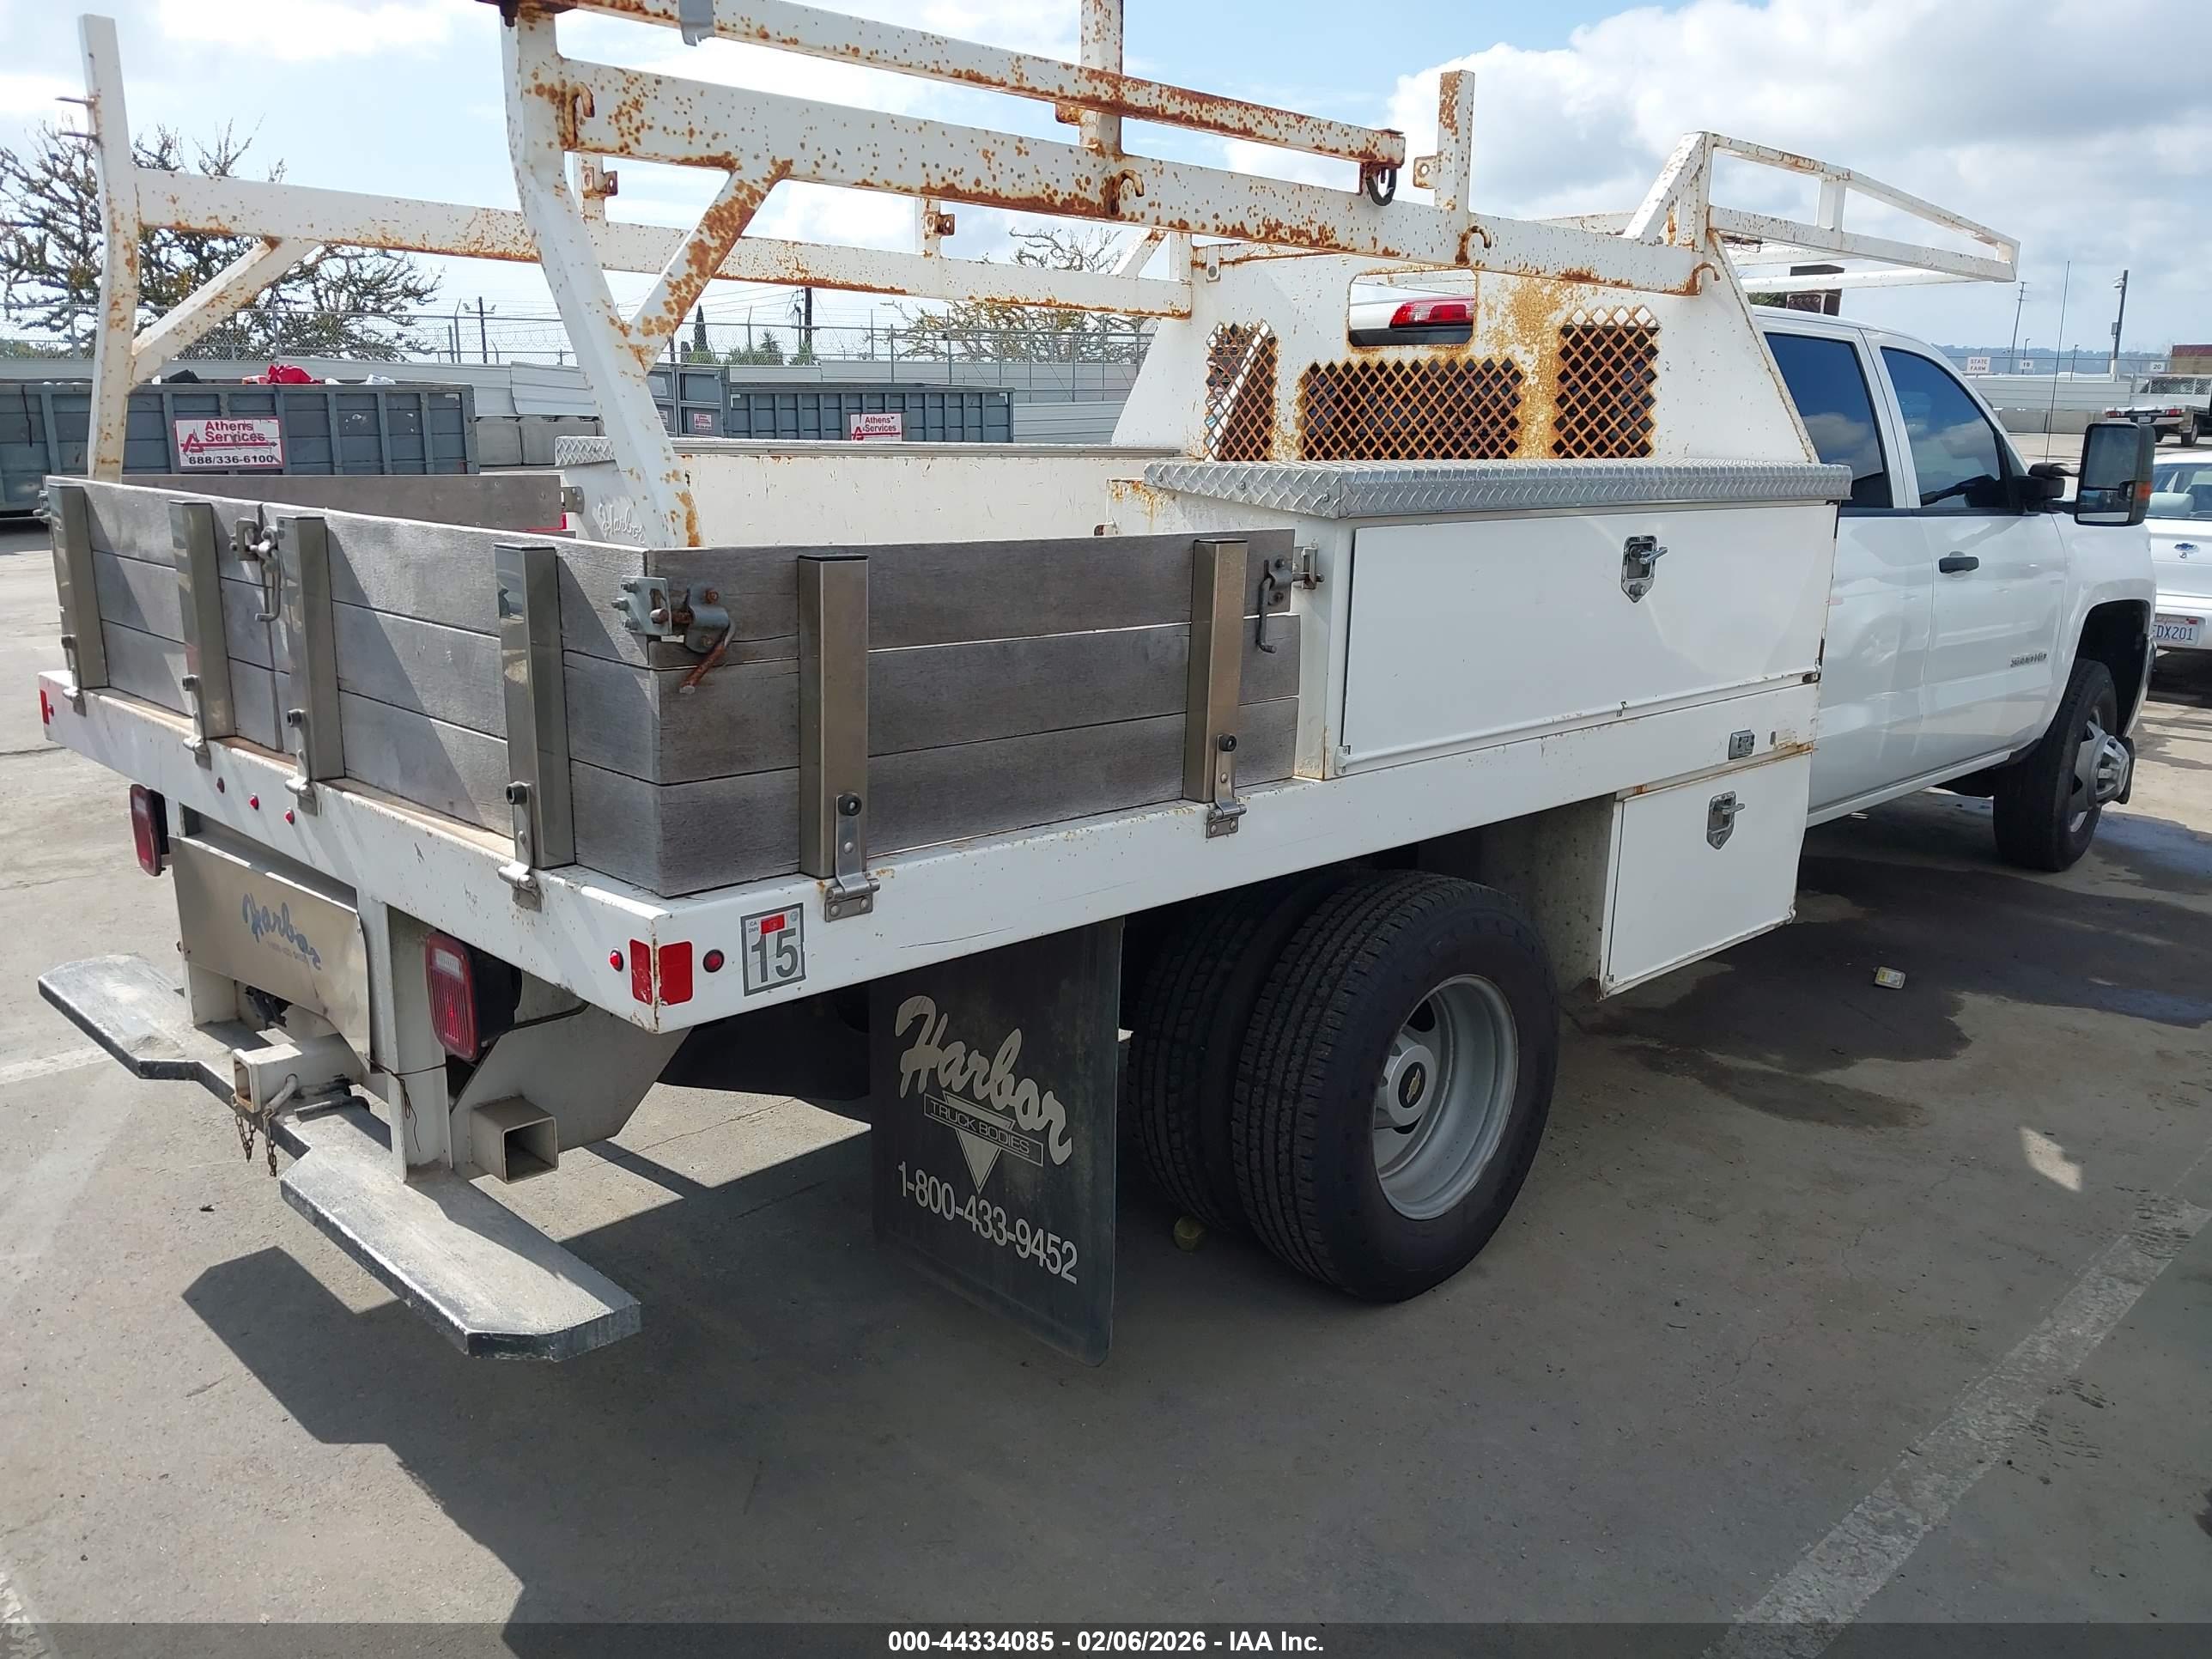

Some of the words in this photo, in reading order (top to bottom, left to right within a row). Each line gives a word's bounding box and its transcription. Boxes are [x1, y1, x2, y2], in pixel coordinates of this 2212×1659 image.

[205, 421, 254, 431] Athens
[865, 416, 891, 424] Athens
[865, 423, 896, 433] Services
[205, 430, 266, 442] Services
[188, 454, 275, 465] 888/336-6100
[751, 927, 799, 983] 15
[896, 995, 1073, 1165] Harbor
[930, 1099, 977, 1133] TRUCK
[979, 1121, 1030, 1155] BODIES
[898, 1161, 1078, 1285] 1-800-433-9452
